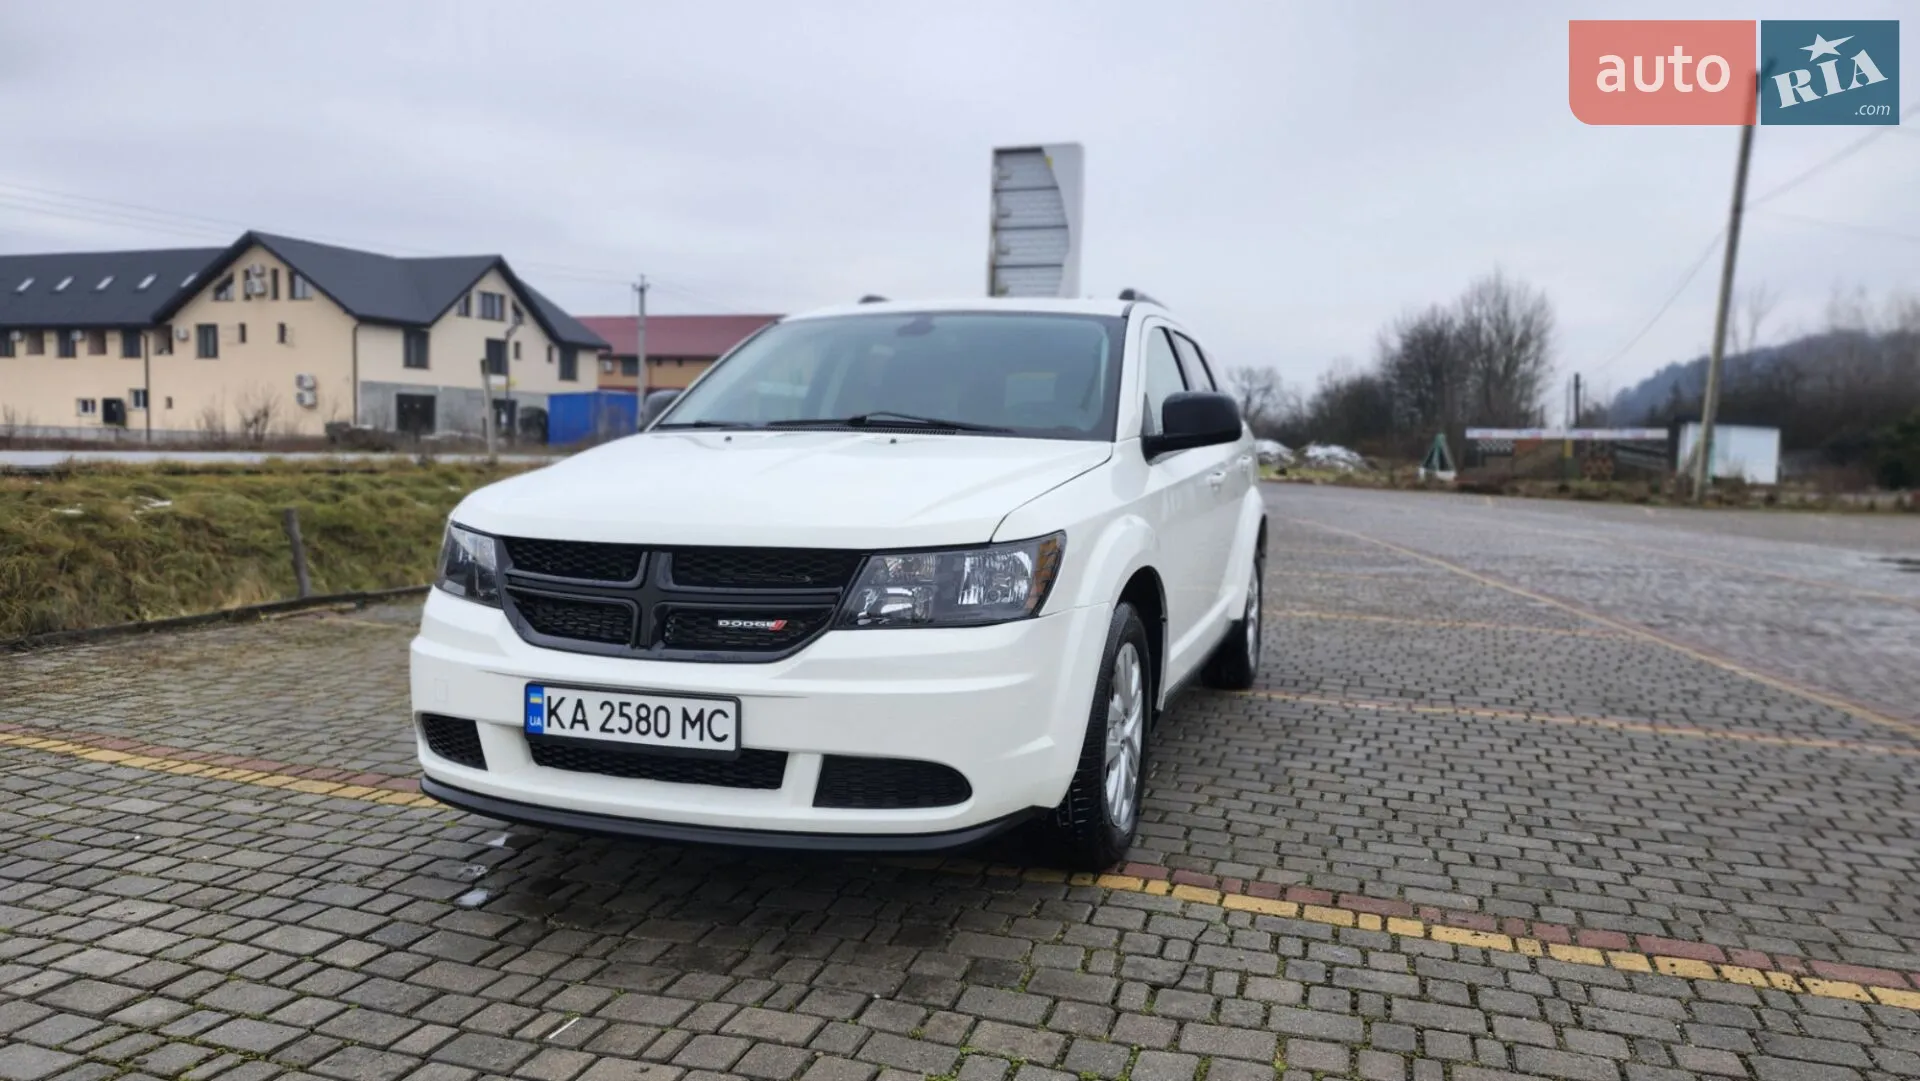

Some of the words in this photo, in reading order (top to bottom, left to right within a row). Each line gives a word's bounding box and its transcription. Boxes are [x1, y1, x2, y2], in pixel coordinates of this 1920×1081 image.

[718, 619, 776, 628] DODGE
[529, 716, 542, 727] UA
[547, 695, 590, 731] KA
[599, 700, 671, 738] 2580
[681, 706, 729, 743] MC
